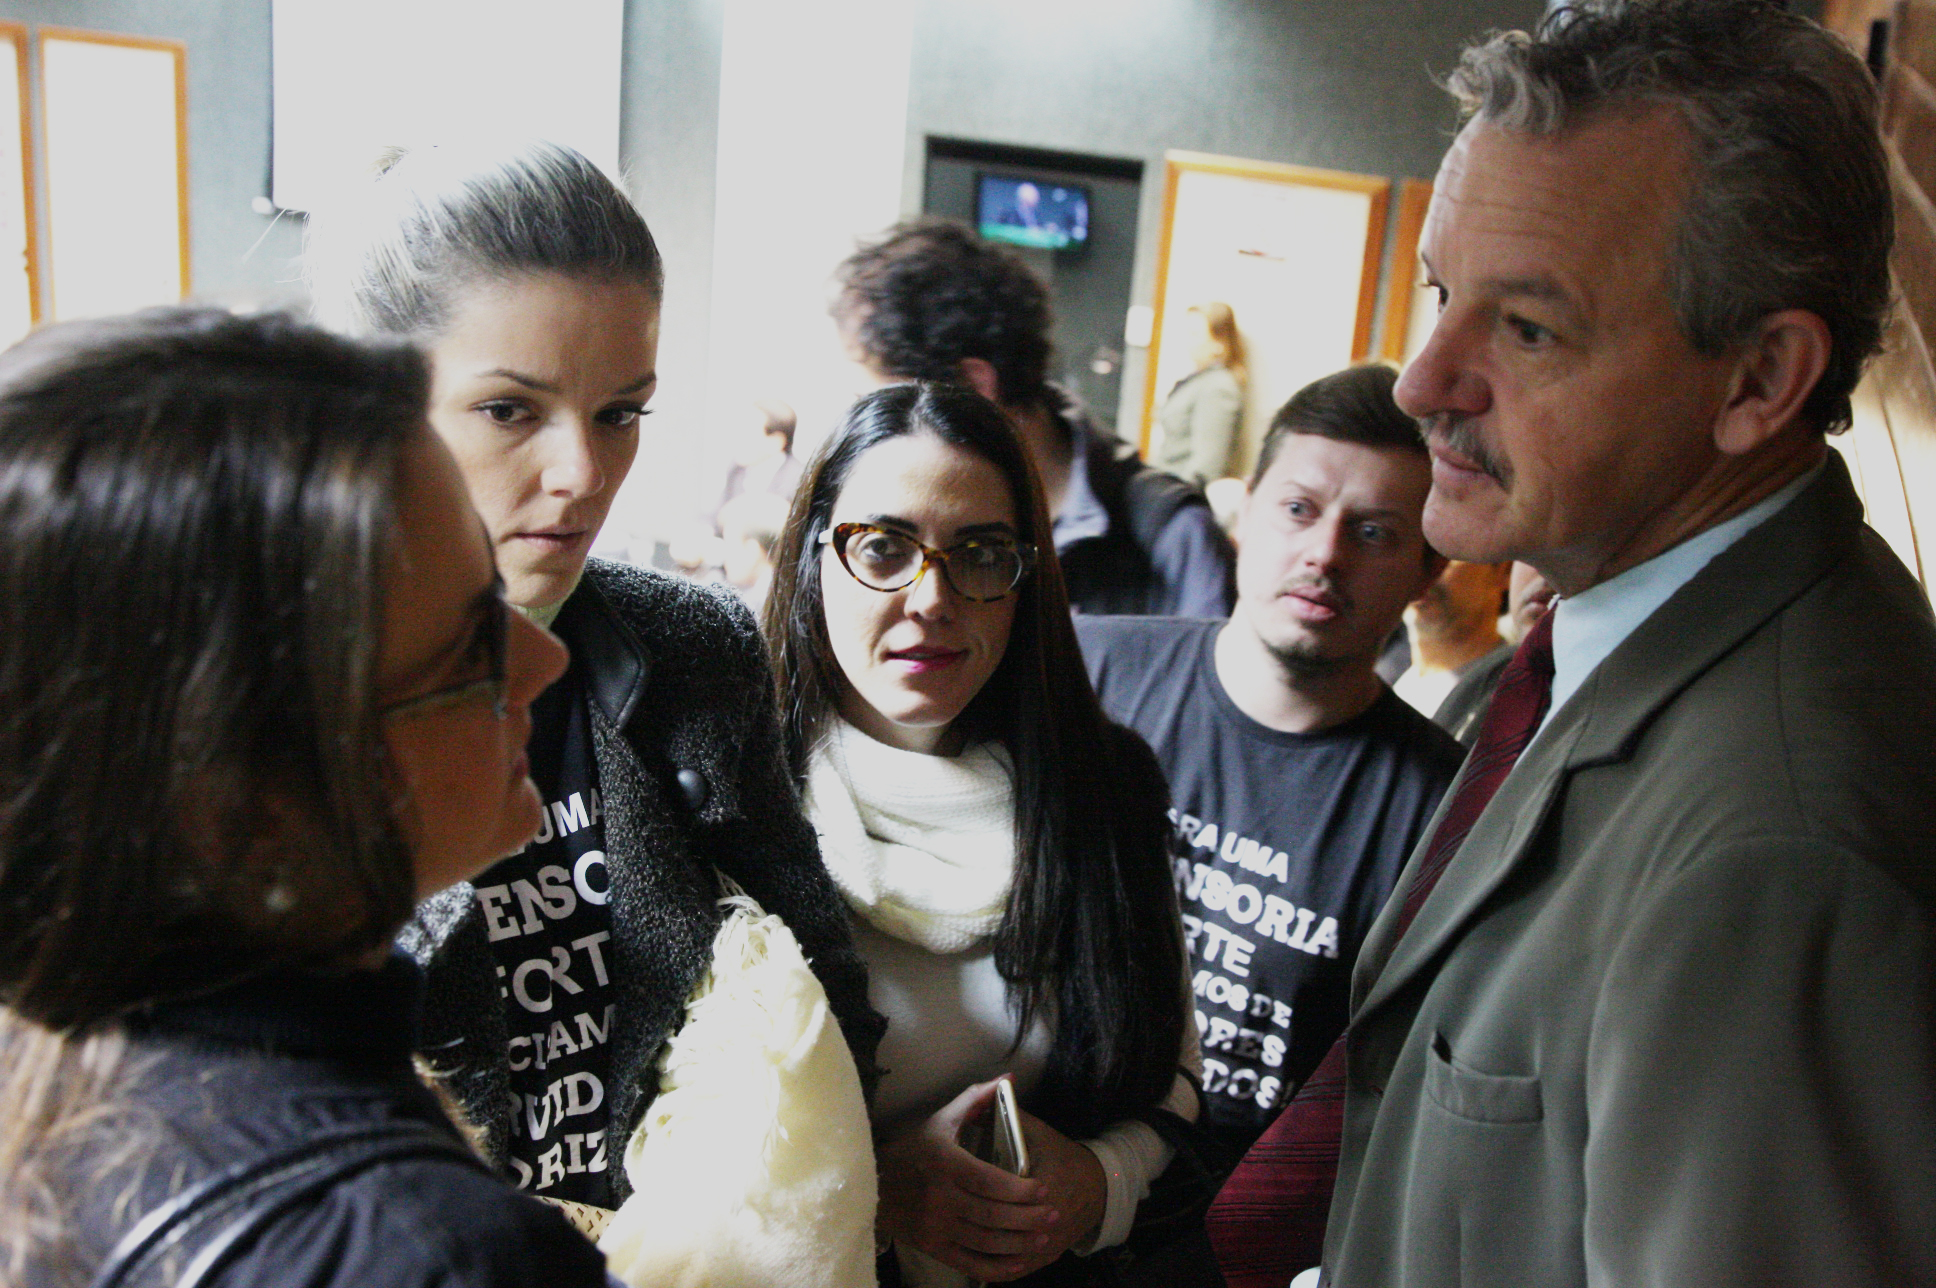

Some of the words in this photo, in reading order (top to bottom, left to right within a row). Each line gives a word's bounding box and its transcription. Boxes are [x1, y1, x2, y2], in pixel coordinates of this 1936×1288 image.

[1219, 832, 1288, 883] UMA
[476, 849, 611, 943] ENSO
[496, 930, 611, 1013] ORT
[1250, 993, 1293, 1029] DE
